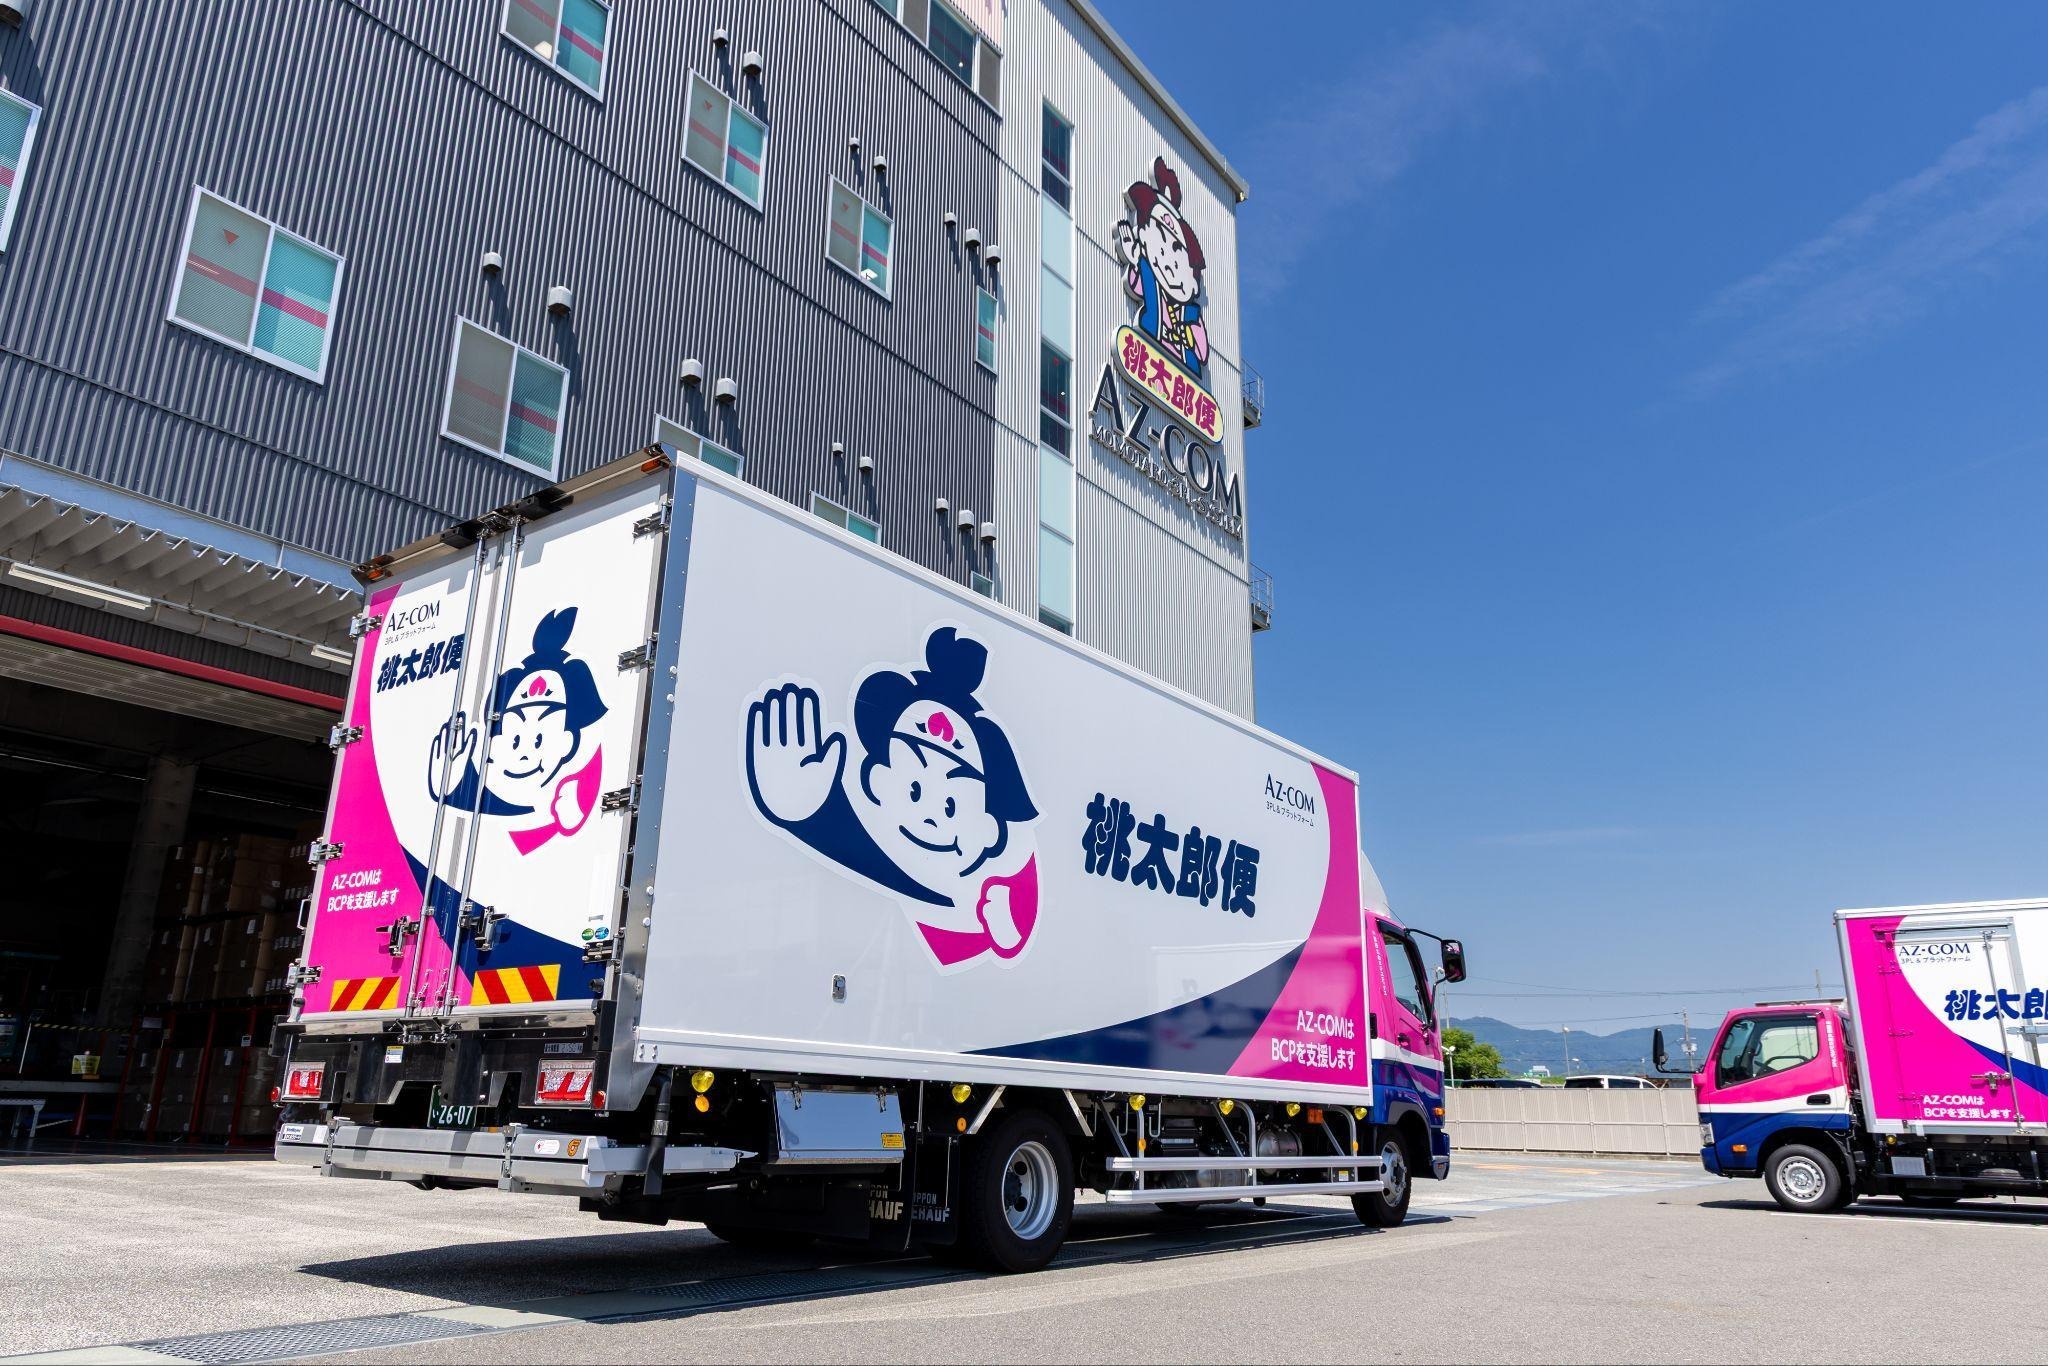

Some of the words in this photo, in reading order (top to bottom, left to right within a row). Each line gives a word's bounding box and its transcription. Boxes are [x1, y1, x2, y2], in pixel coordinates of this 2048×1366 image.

[1123, 333, 1218, 437] 桃太郎便
[1089, 361, 1242, 520] AZ-COM
[1091, 424, 1168, 487] MOMOTARO
[385, 600, 440, 634] AZ-COM
[376, 633, 466, 693] 桃太郎便
[1265, 773, 1315, 815] AZ-COM
[1082, 792, 1260, 918] 桃太郎便
[331, 868, 382, 890] AZ-COMは
[327, 887, 399, 912] BCPを支援します
[1899, 943, 1971, 956] AZ-COM
[1296, 1009, 1355, 1039] AZ-COMは
[1271, 1037, 1356, 1071] BCPを支援します
[1923, 1094, 1985, 1105] AZ-COMは
[1923, 1107, 2012, 1119] BCPを支援します
